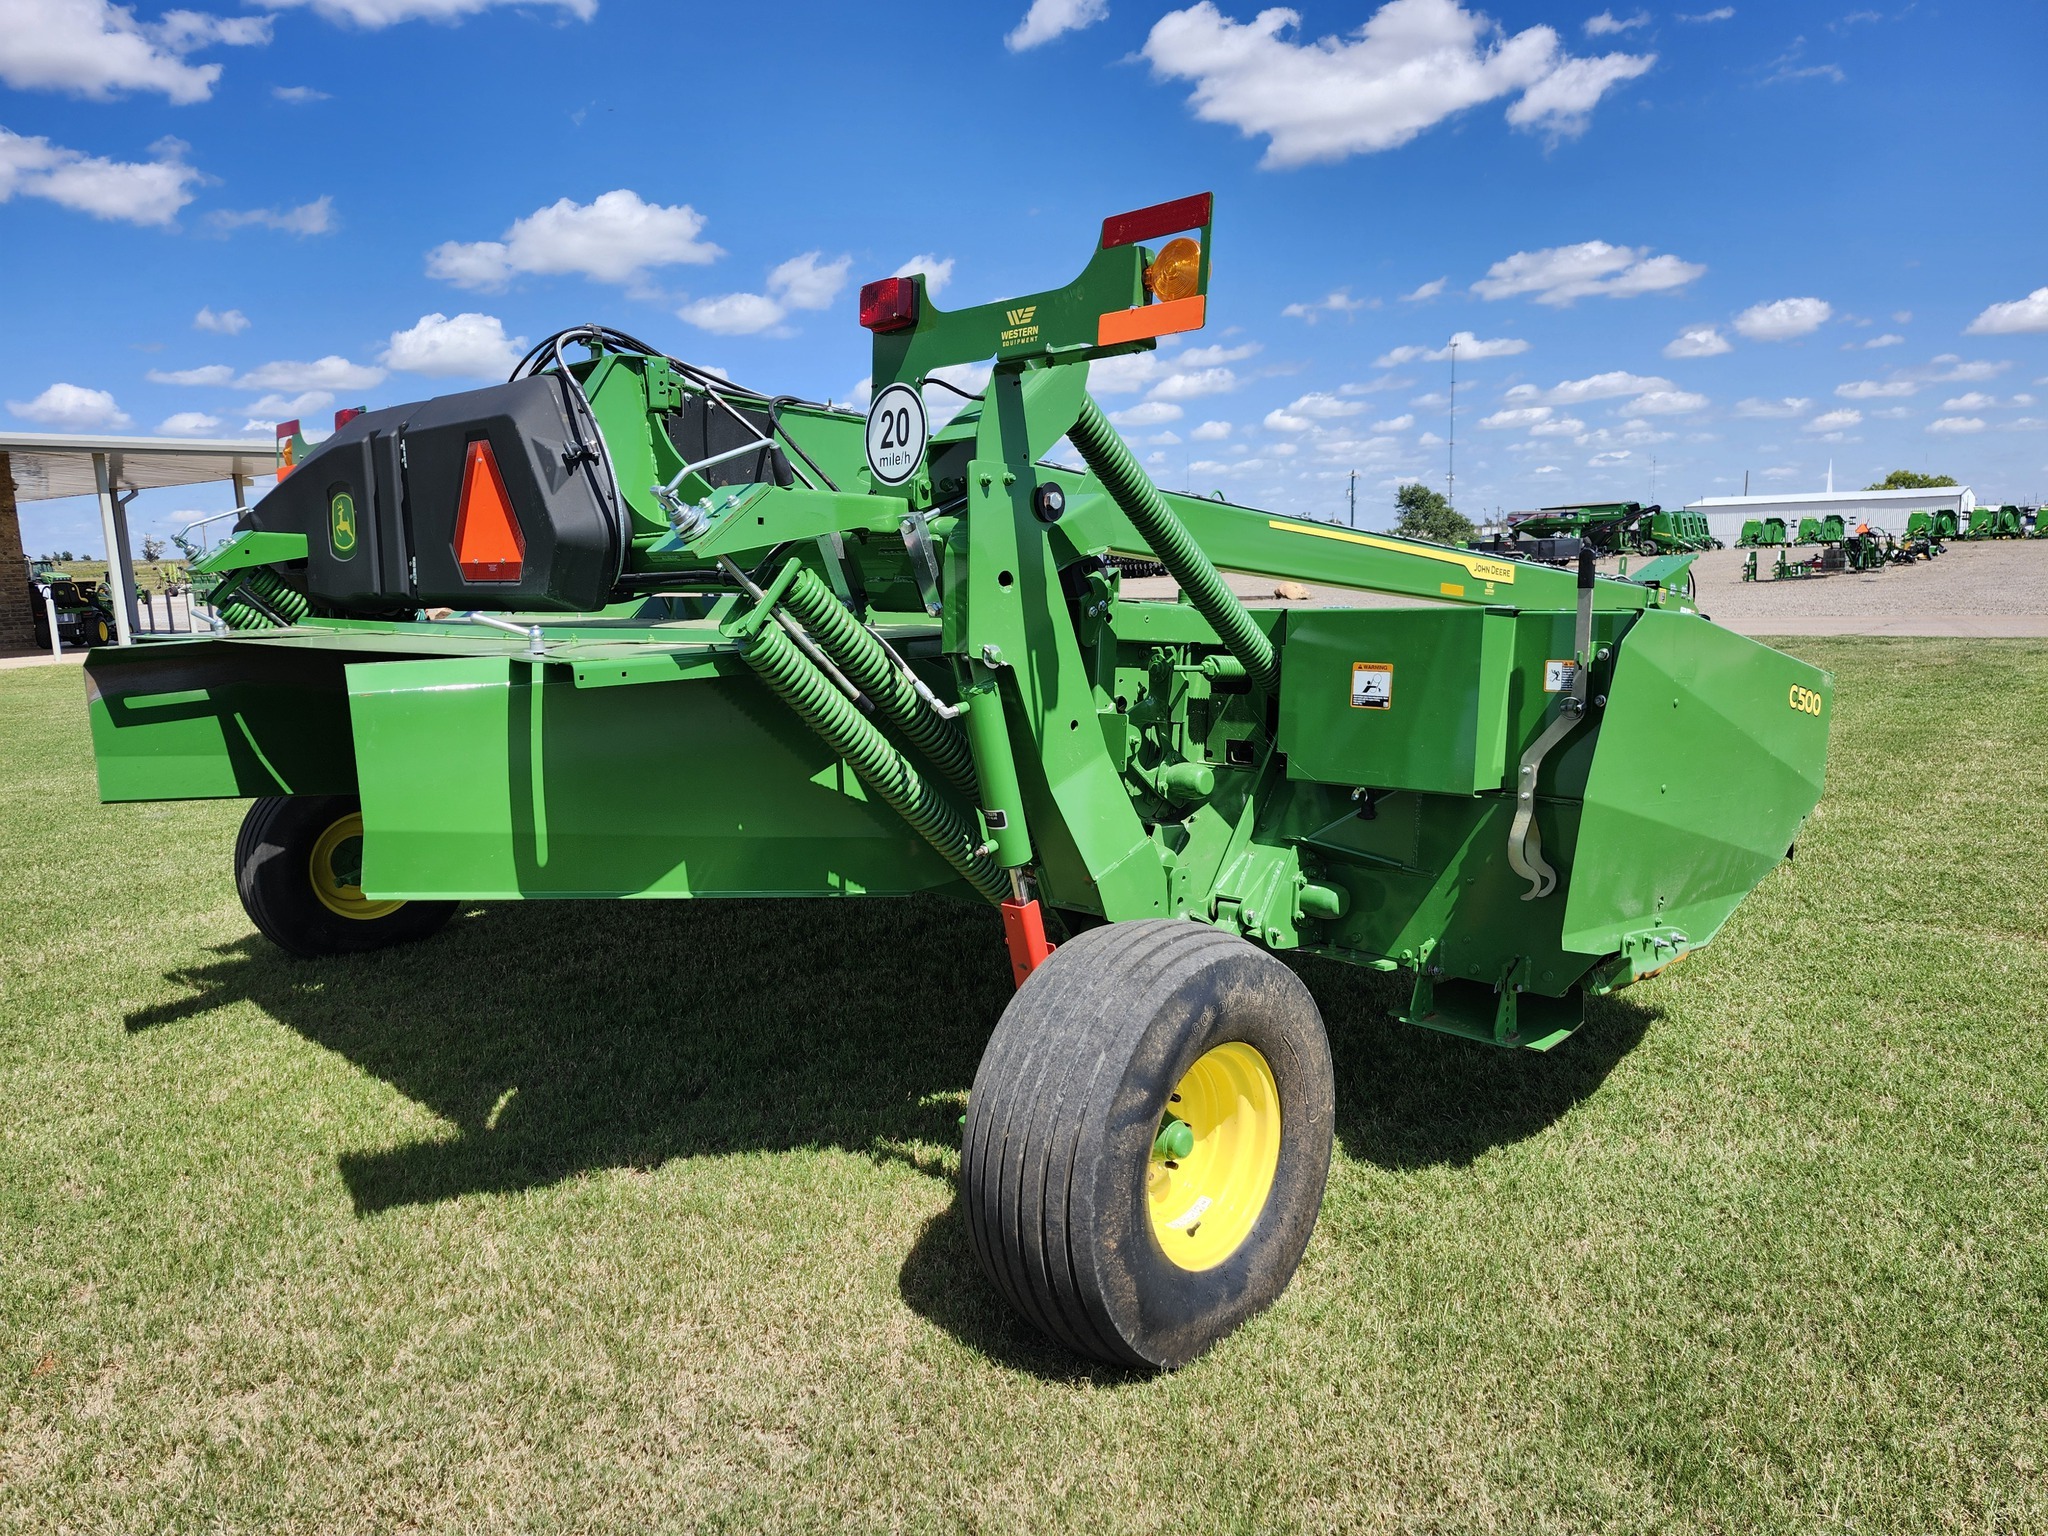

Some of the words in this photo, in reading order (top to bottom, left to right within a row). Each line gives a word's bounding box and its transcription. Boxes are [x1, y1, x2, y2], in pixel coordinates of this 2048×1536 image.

[1001, 325, 1039, 341] WESTERN
[1002, 335, 1038, 347] EQUIPMENT
[880, 407, 910, 449] 20
[879, 451, 911, 467] mile/h
[1473, 562, 1491, 574] JOHN
[1490, 565, 1511, 577] DEERE
[1789, 683, 1821, 717] C500
[1190, 988, 1275, 1036] GOODE
